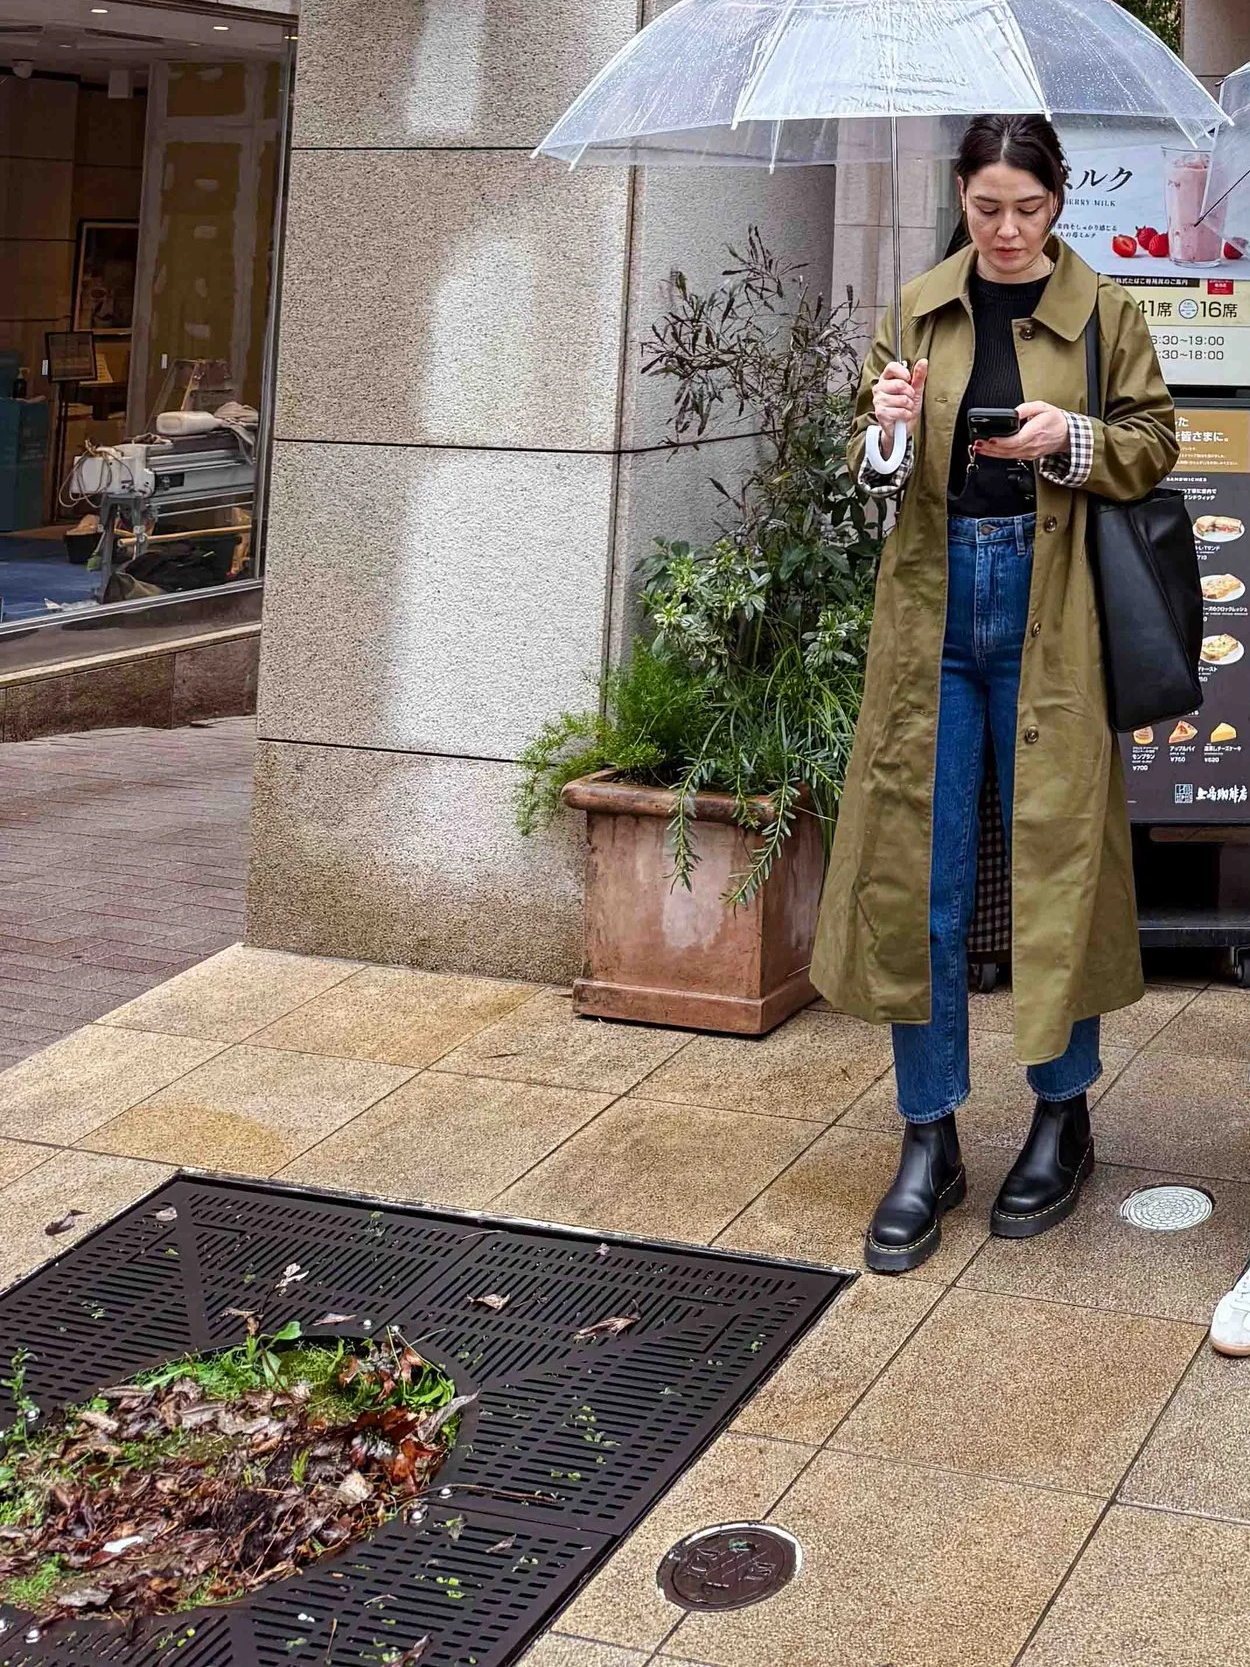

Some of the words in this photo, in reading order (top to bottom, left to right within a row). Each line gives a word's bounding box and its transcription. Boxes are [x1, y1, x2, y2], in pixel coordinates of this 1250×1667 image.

[1200, 300, 1239, 318] 16席
[1196, 784, 1248, 804] 上島珈琲店
